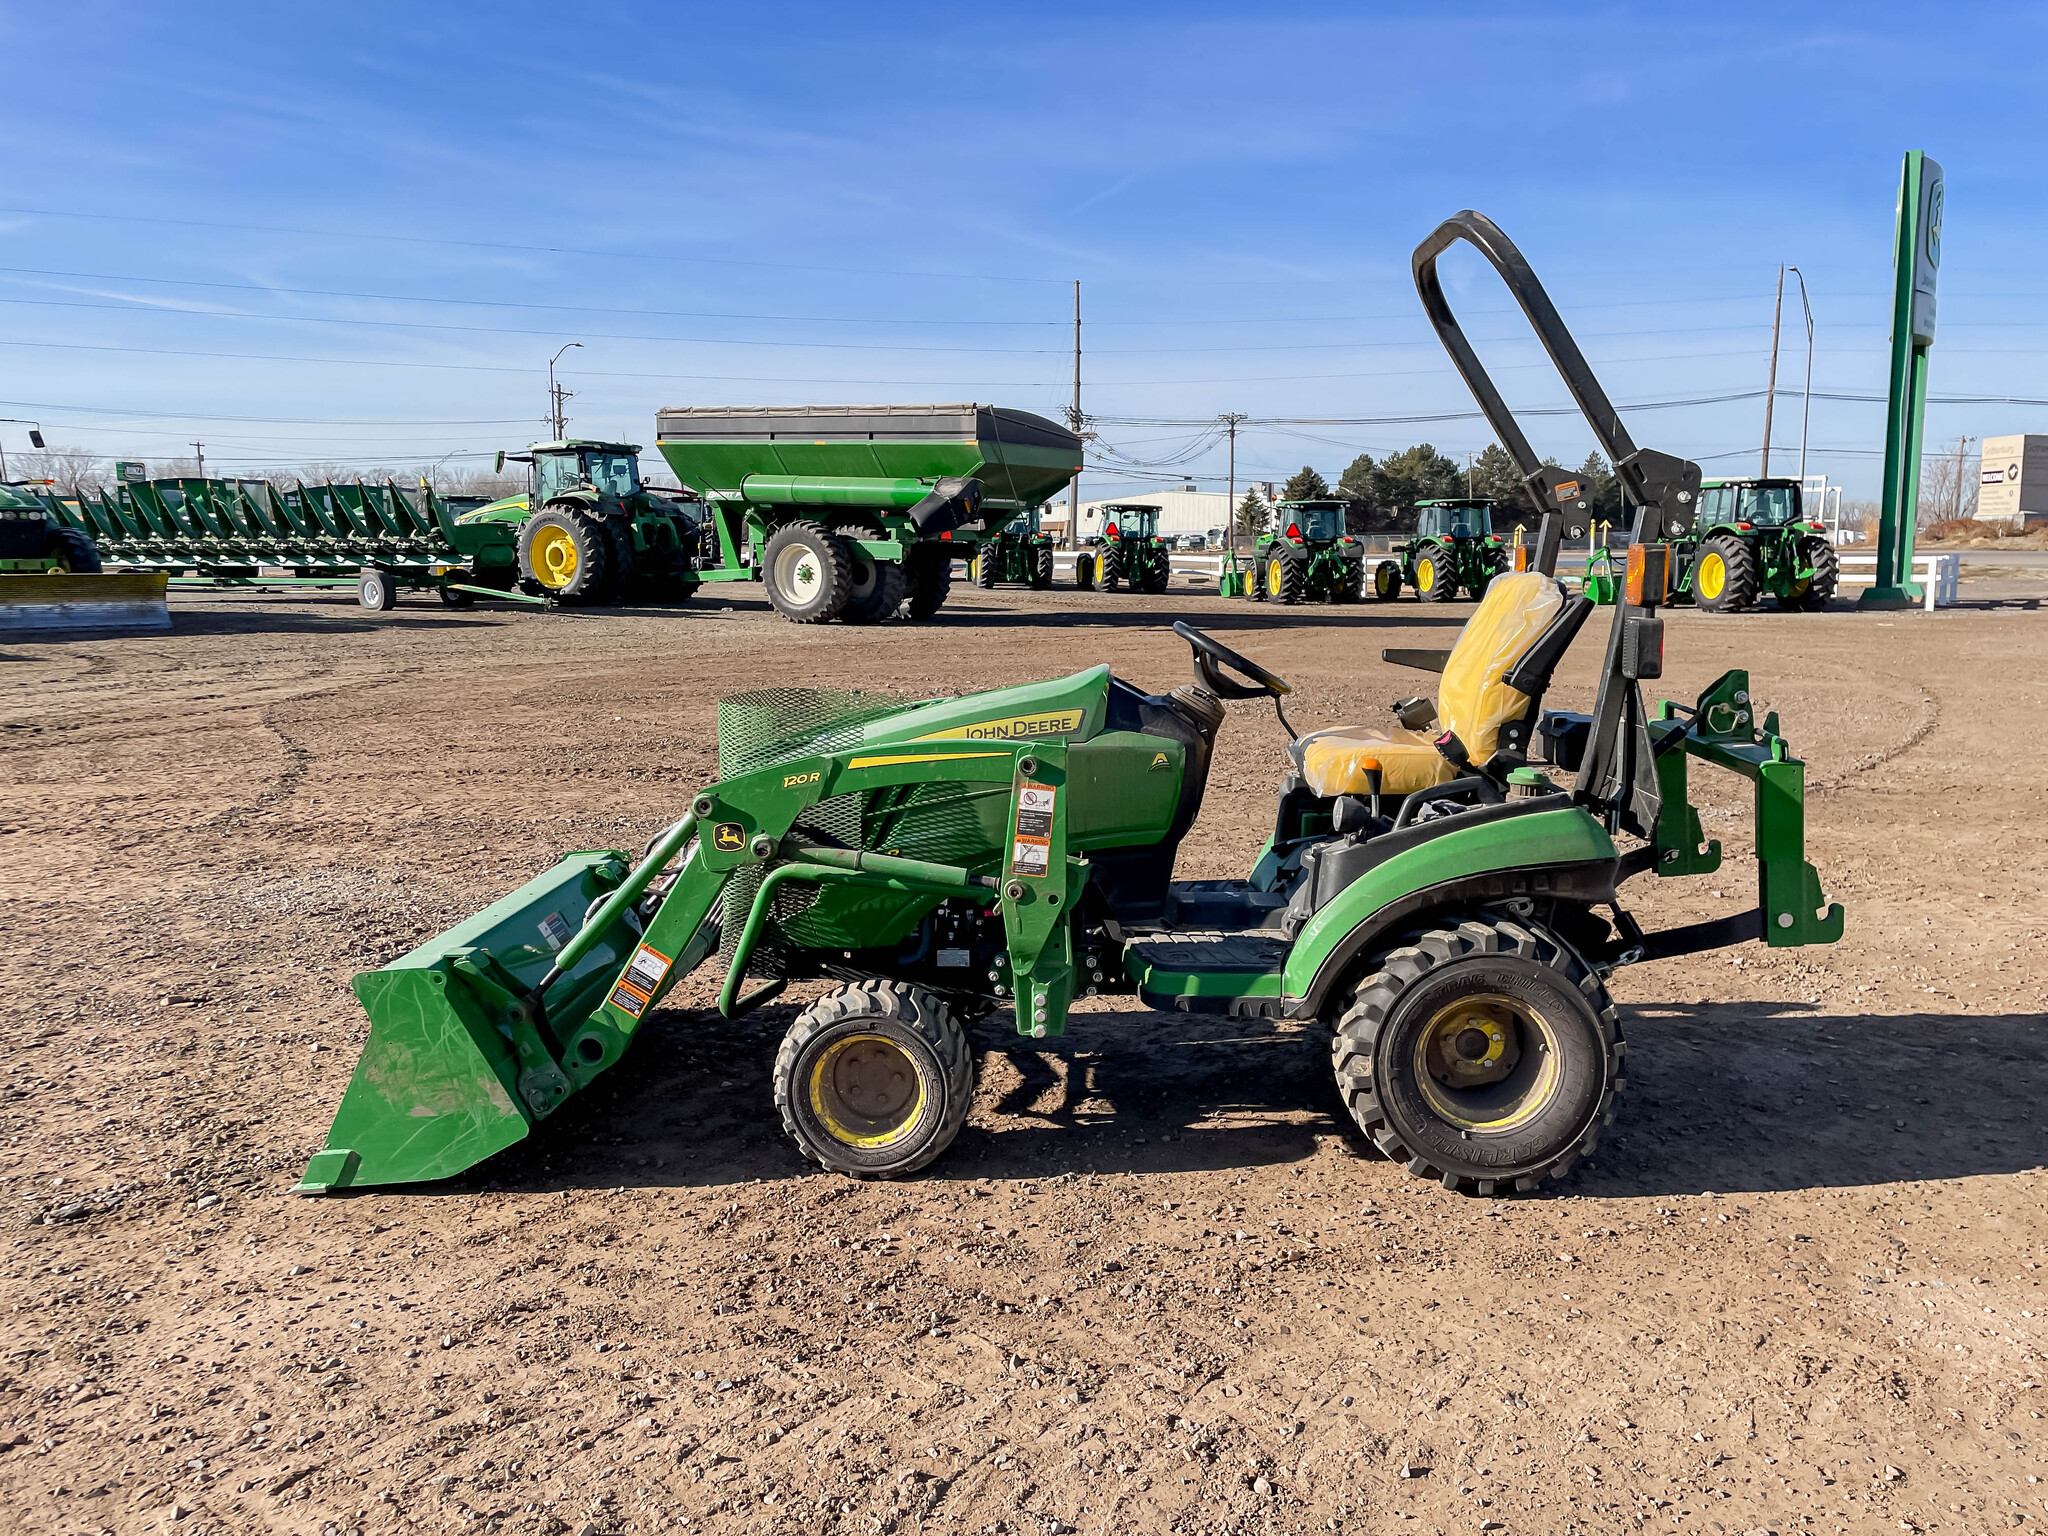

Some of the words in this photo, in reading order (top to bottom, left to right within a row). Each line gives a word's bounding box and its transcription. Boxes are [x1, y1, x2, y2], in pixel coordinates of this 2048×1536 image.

[966, 725, 1009, 739] JOHN
[1013, 718, 1072, 736] DEERE
[783, 774, 808, 788] 120
[809, 772, 821, 783] R
